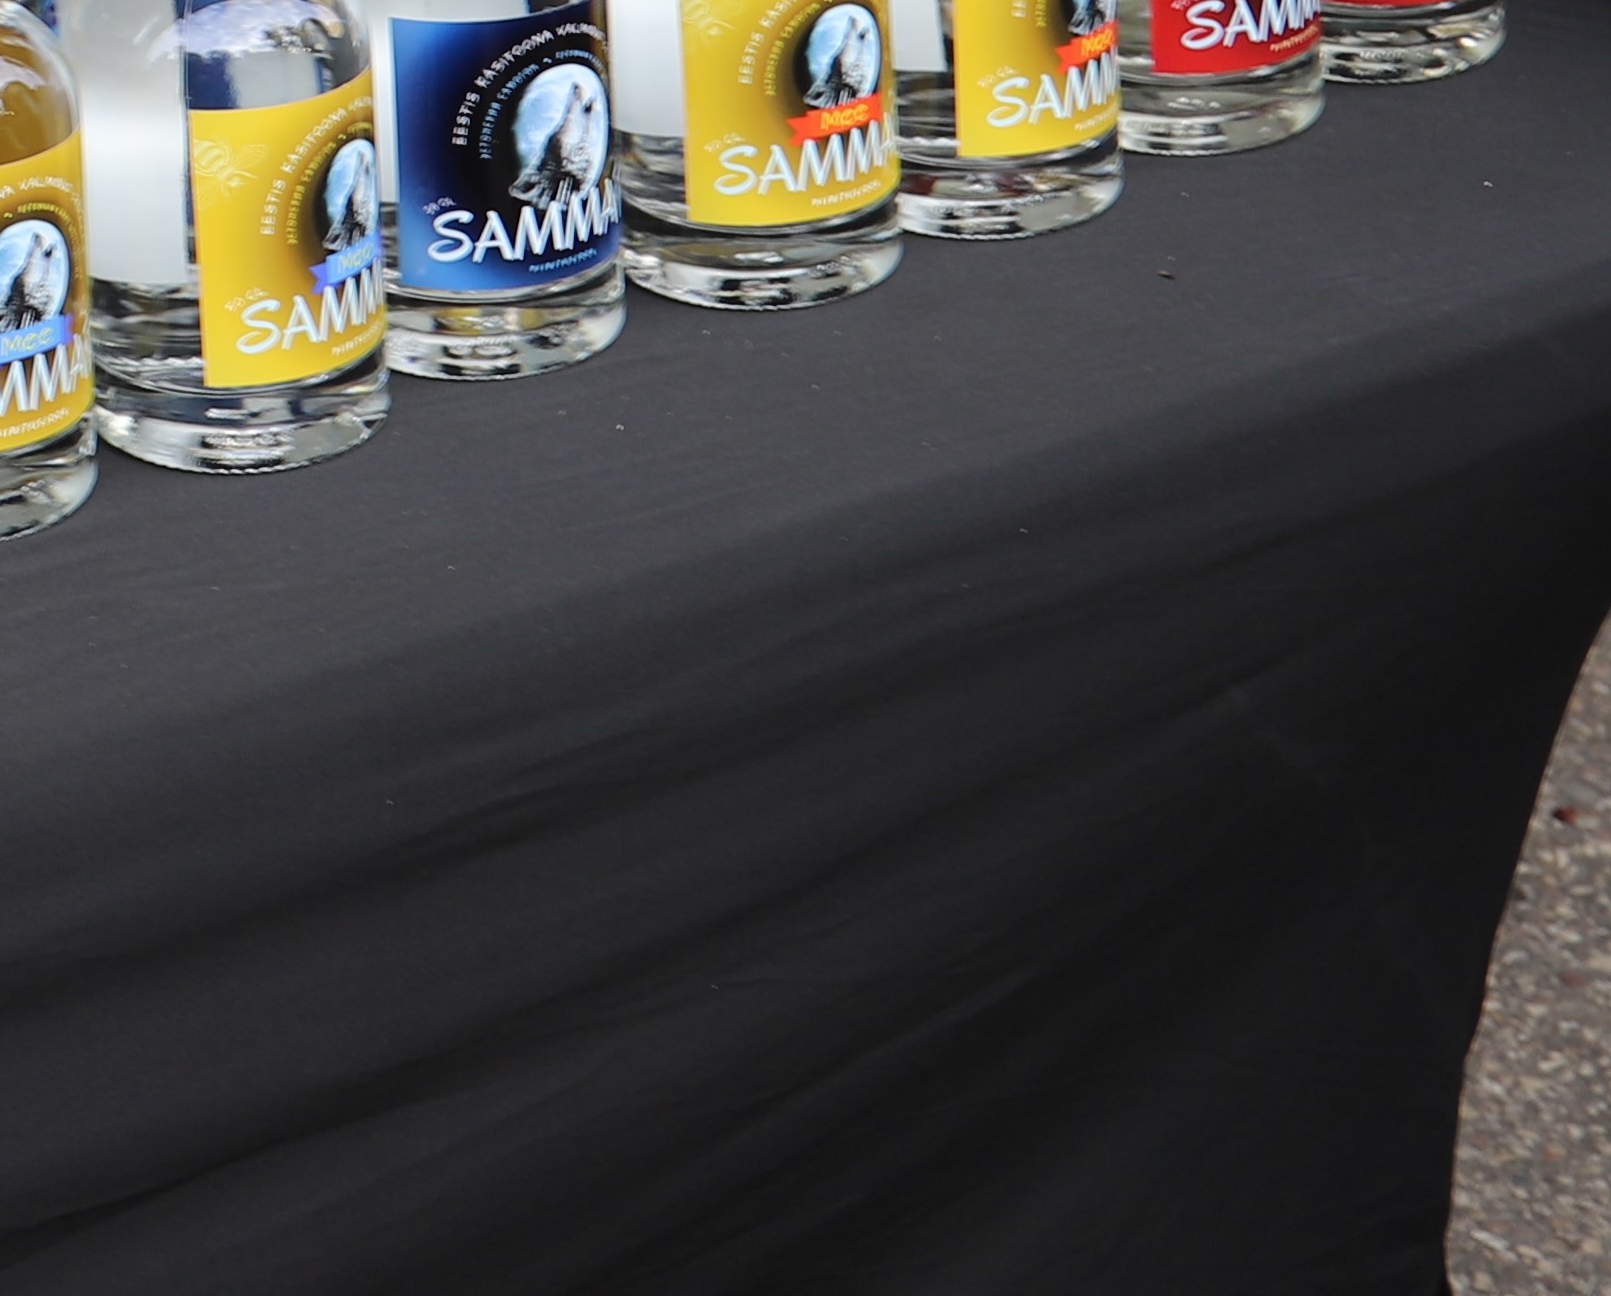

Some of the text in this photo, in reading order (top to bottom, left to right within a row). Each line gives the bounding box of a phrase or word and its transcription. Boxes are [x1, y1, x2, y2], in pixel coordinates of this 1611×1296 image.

[738, 32, 764, 85] EESTIS
[452, 91, 480, 146] EESTIS
[260, 179, 286, 235] EESTIS
